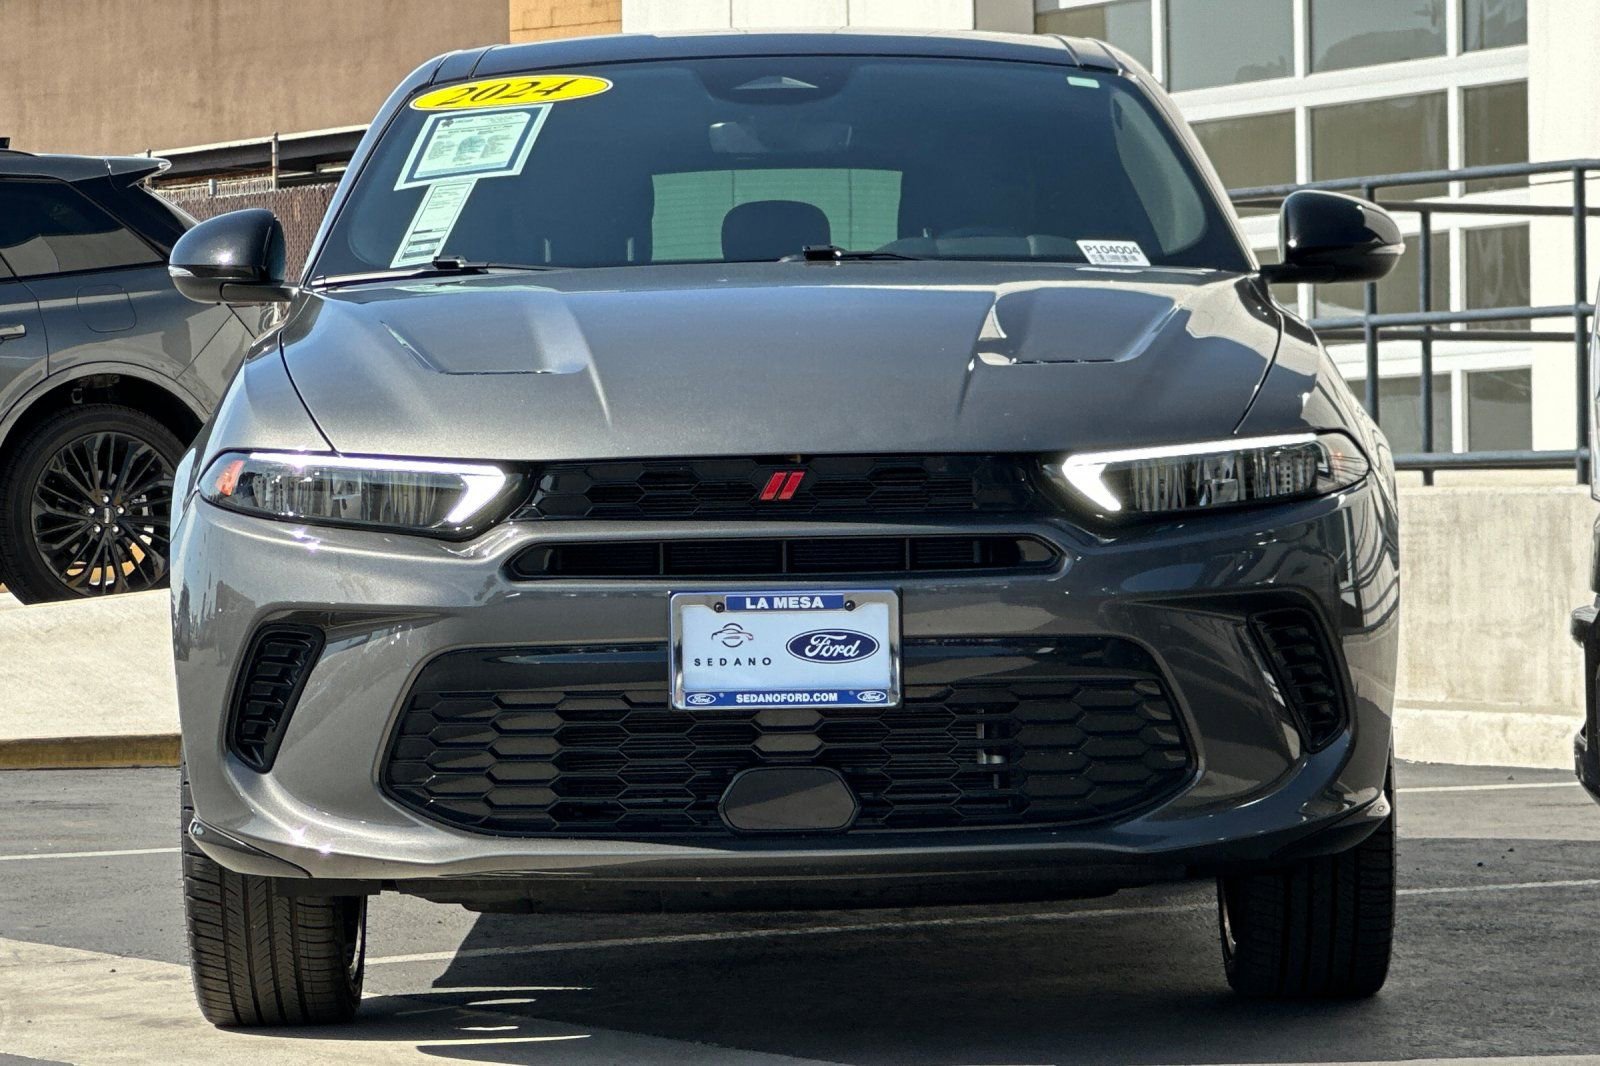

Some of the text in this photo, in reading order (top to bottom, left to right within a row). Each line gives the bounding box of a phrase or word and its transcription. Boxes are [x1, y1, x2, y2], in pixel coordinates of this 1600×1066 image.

[435, 79, 579, 106] 2024
[1083, 245, 1141, 255] P104004
[745, 596, 825, 610] LA MESA
[804, 634, 861, 658] Ford
[694, 657, 772, 667] SEDANO
[735, 692, 838, 704] SEDANOFORD.COM
